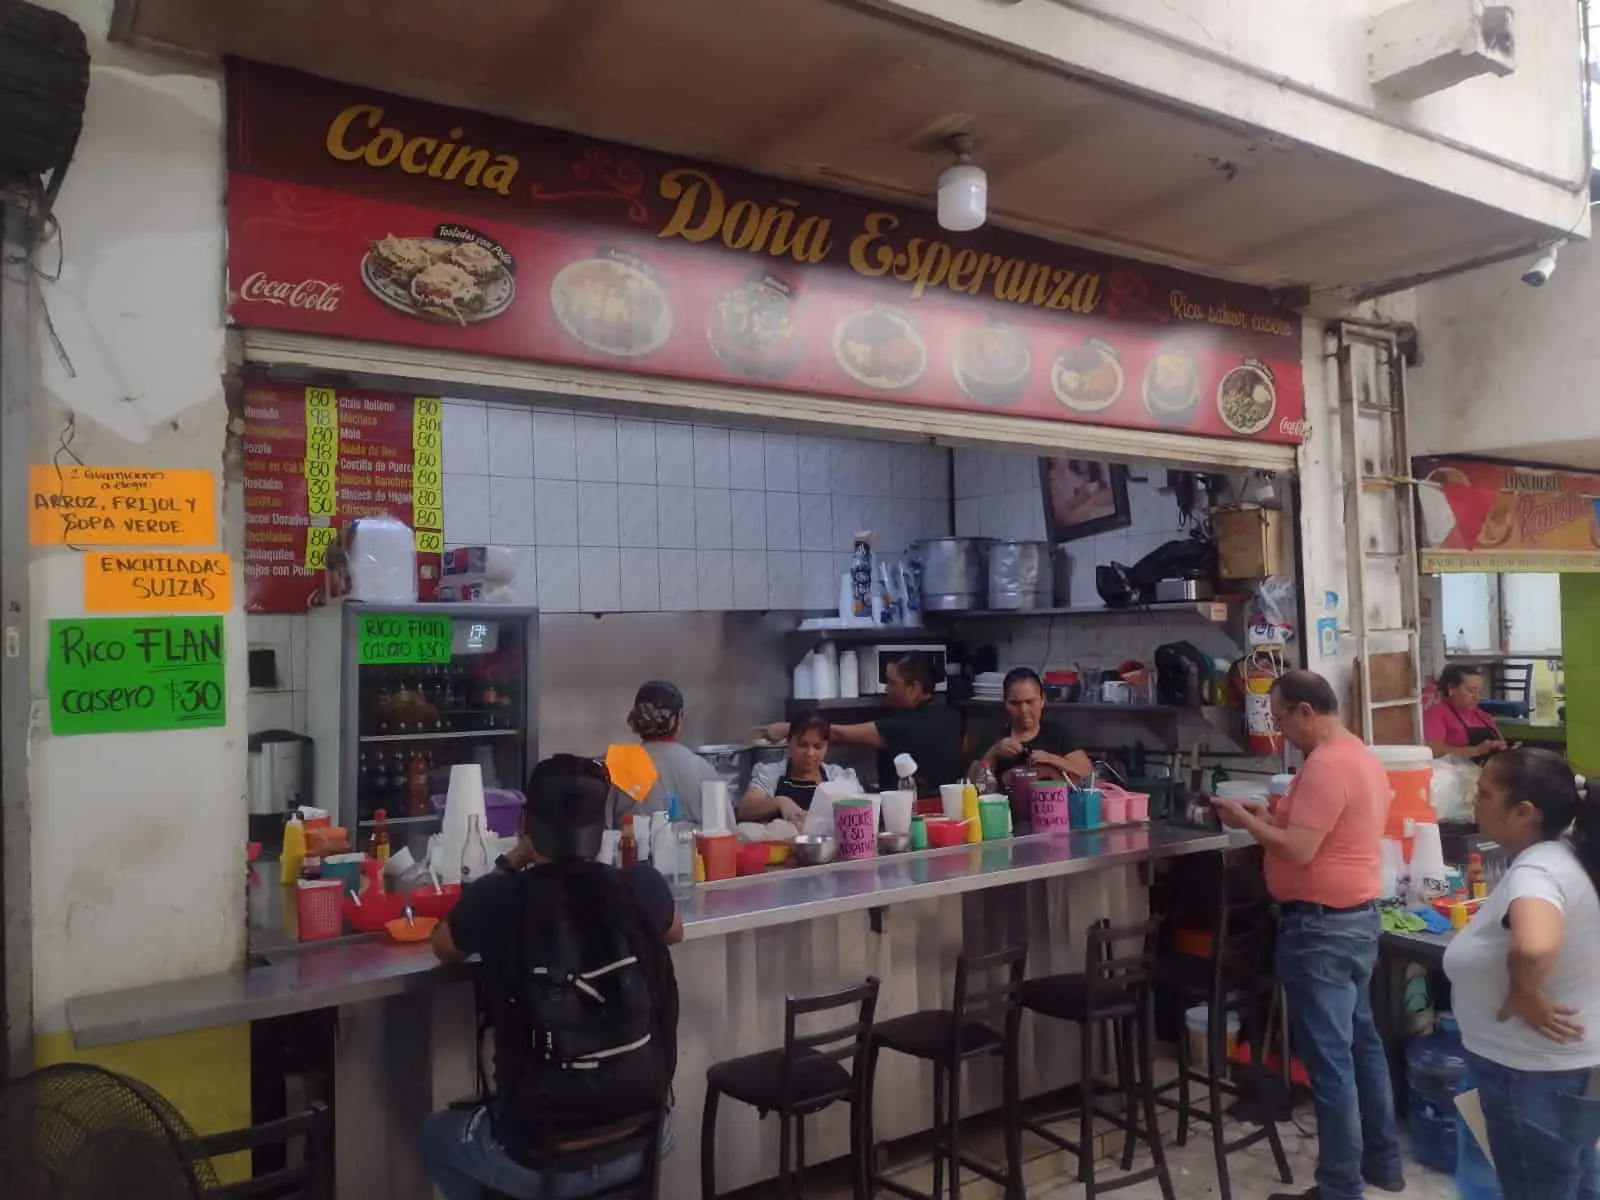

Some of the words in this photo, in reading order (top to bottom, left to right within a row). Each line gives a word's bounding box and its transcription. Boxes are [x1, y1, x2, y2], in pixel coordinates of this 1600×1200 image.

[325, 104, 520, 195] Cocina
[657, 168, 833, 264] Doña
[849, 212, 1101, 314] Esperanza
[440, 226, 475, 241] Tostadas
[241, 272, 344, 312] Coca-Cola
[310, 390, 329, 406] 80
[312, 427, 332, 443] 80
[417, 431, 436, 448] 80
[418, 452, 436, 467] 80
[309, 461, 330, 477] 80
[310, 479, 330, 495] 30
[112, 496, 182, 514] FRIJOL
[185, 497, 197, 513] Y
[310, 497, 331, 513] 30
[418, 488, 436, 505] 80
[64, 512, 116, 531] SOPA
[124, 517, 184, 534] VERDE
[417, 509, 437, 526] 80
[311, 528, 331, 546] 80
[420, 533, 440, 549] 80
[101, 557, 227, 576] ENCHILADAS
[133, 578, 215, 600] SUIZAS
[133, 624, 223, 664] FLAN
[169, 678, 223, 712] $30
